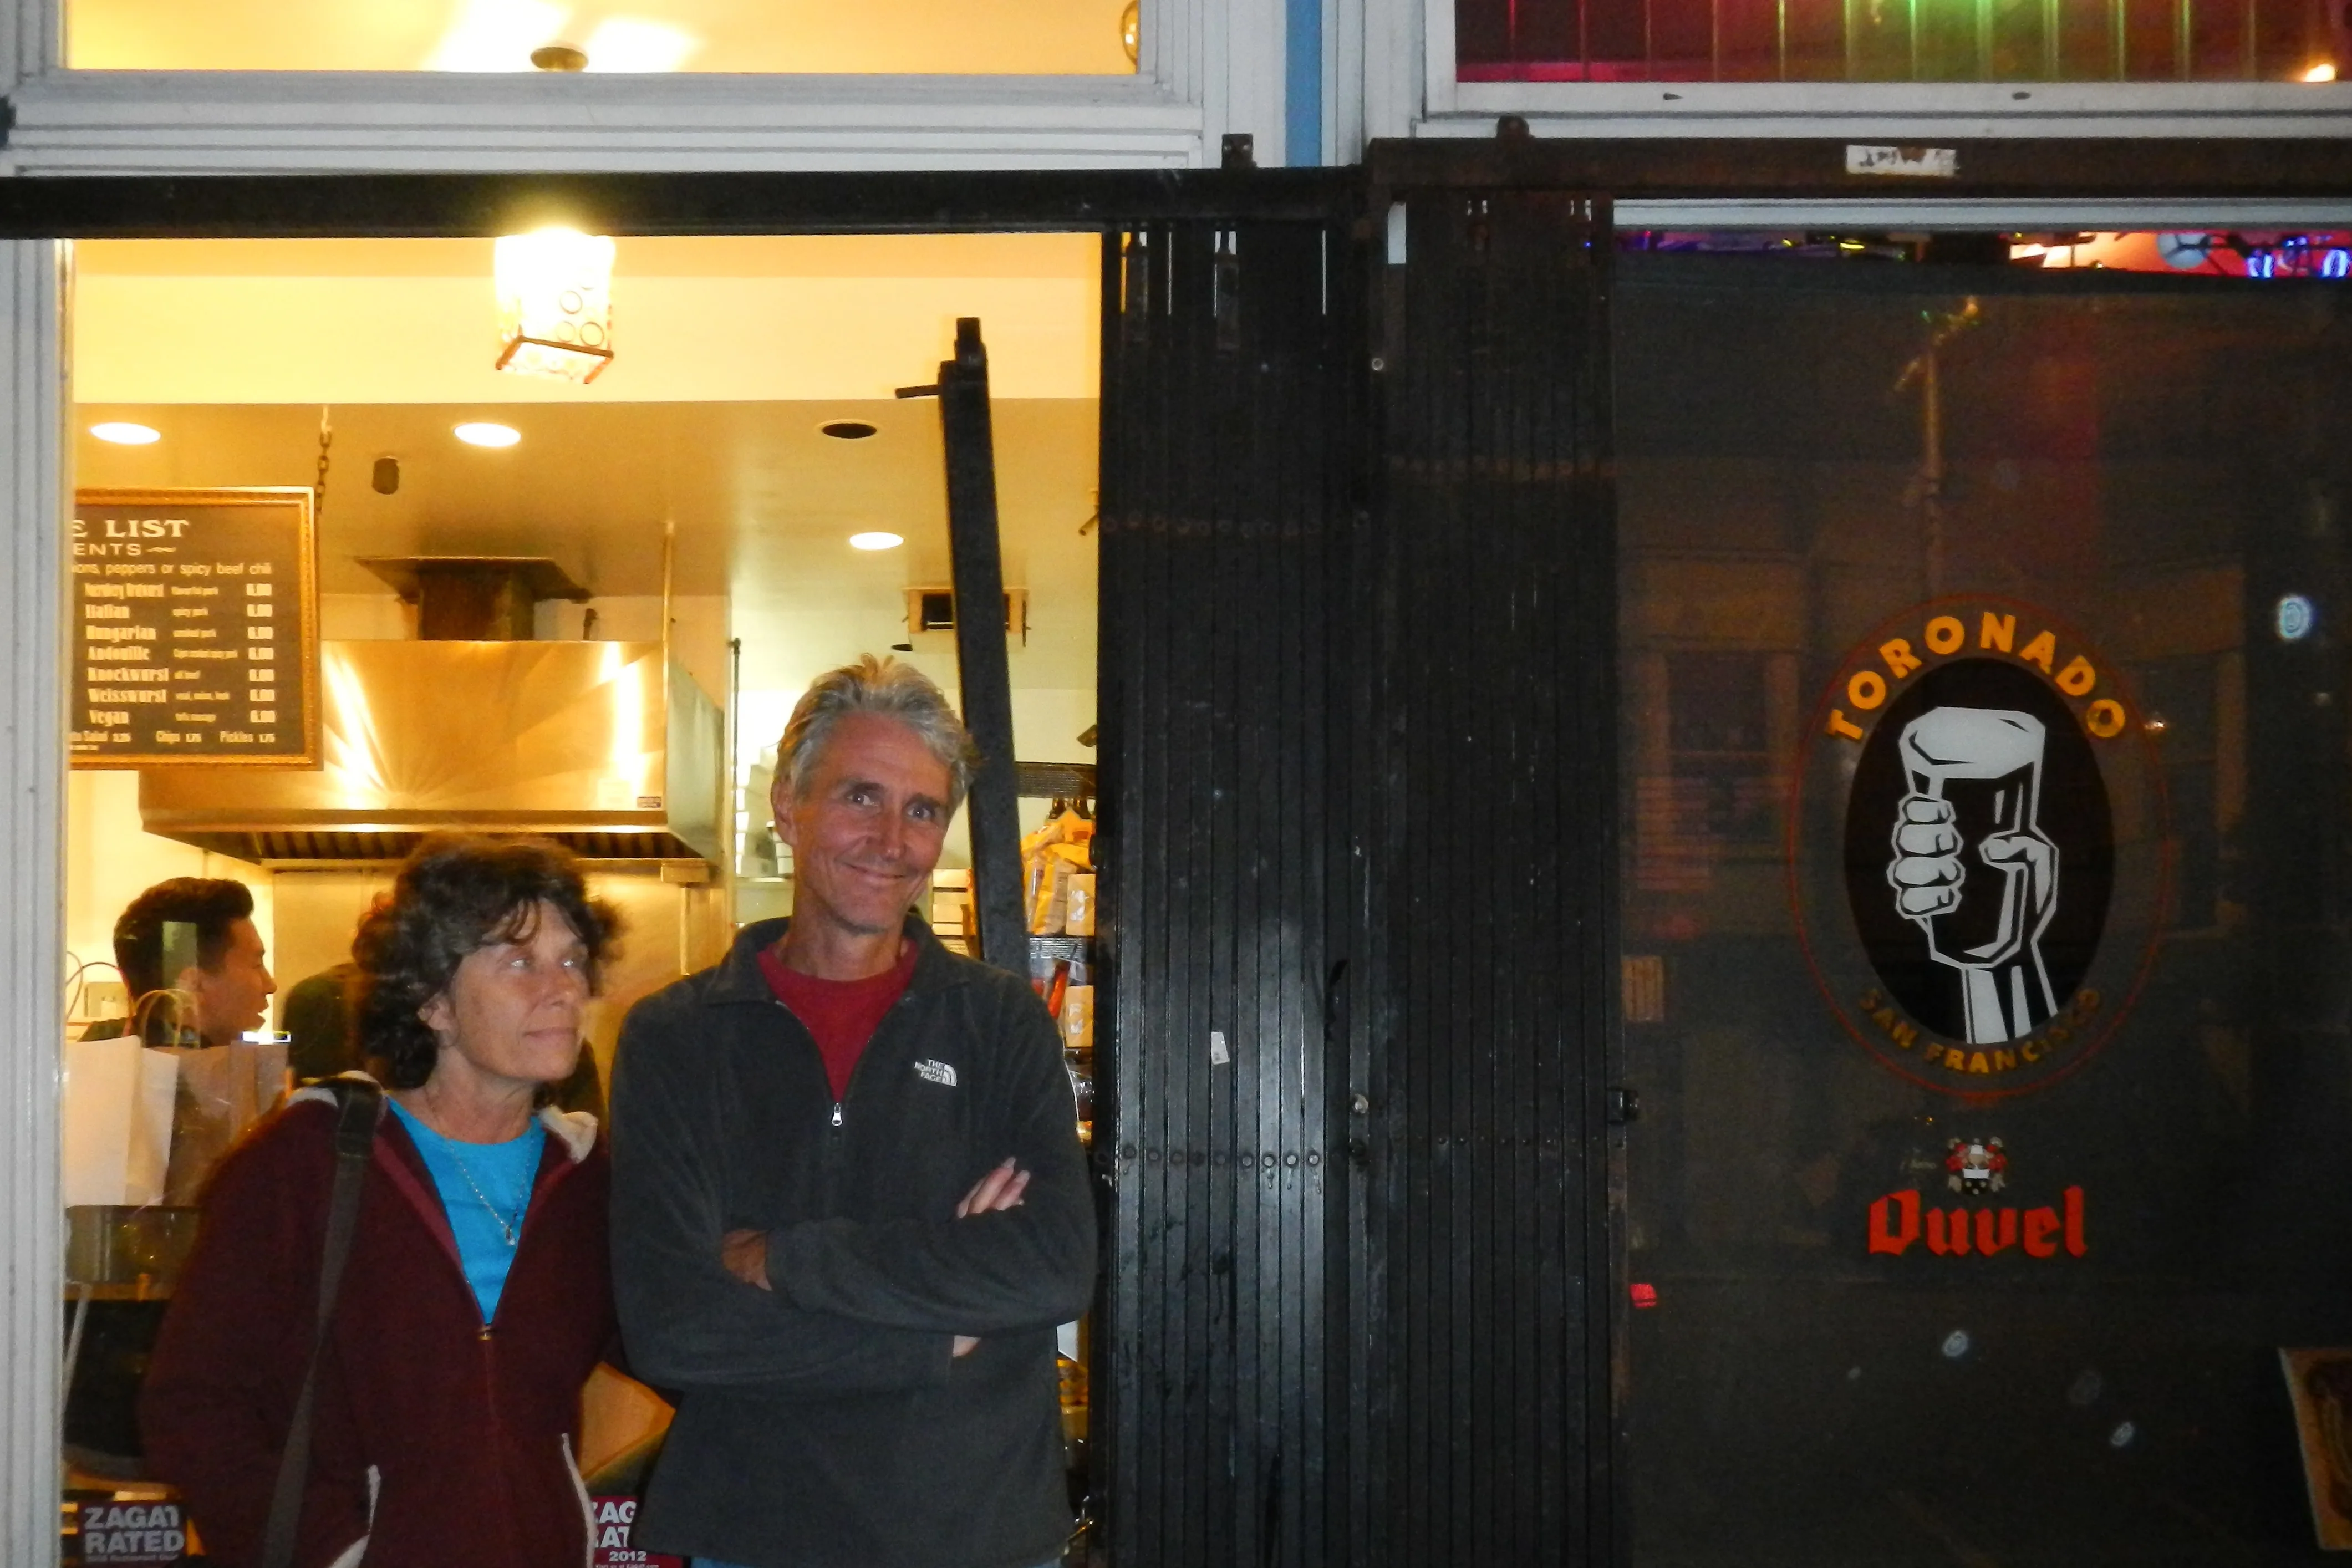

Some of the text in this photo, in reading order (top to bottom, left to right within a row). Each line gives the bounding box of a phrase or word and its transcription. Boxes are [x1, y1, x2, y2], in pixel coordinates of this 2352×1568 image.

[105, 519, 190, 538] LIST
[106, 564, 156, 576] peppers
[161, 564, 174, 574] or
[180, 562, 211, 577] spicy
[216, 562, 245, 574] beef
[1826, 612, 2126, 741] TORONADO
[89, 709, 130, 726] Vegan
[914, 1061, 943, 1076] NORTH
[928, 1058, 944, 1068] THE
[921, 1071, 942, 1082] FACE
[1869, 1185, 2088, 1258] Duvel
[85, 1505, 179, 1529] ZAGAT
[85, 1530, 185, 1554] RATED
[609, 1551, 647, 1562] 2012
